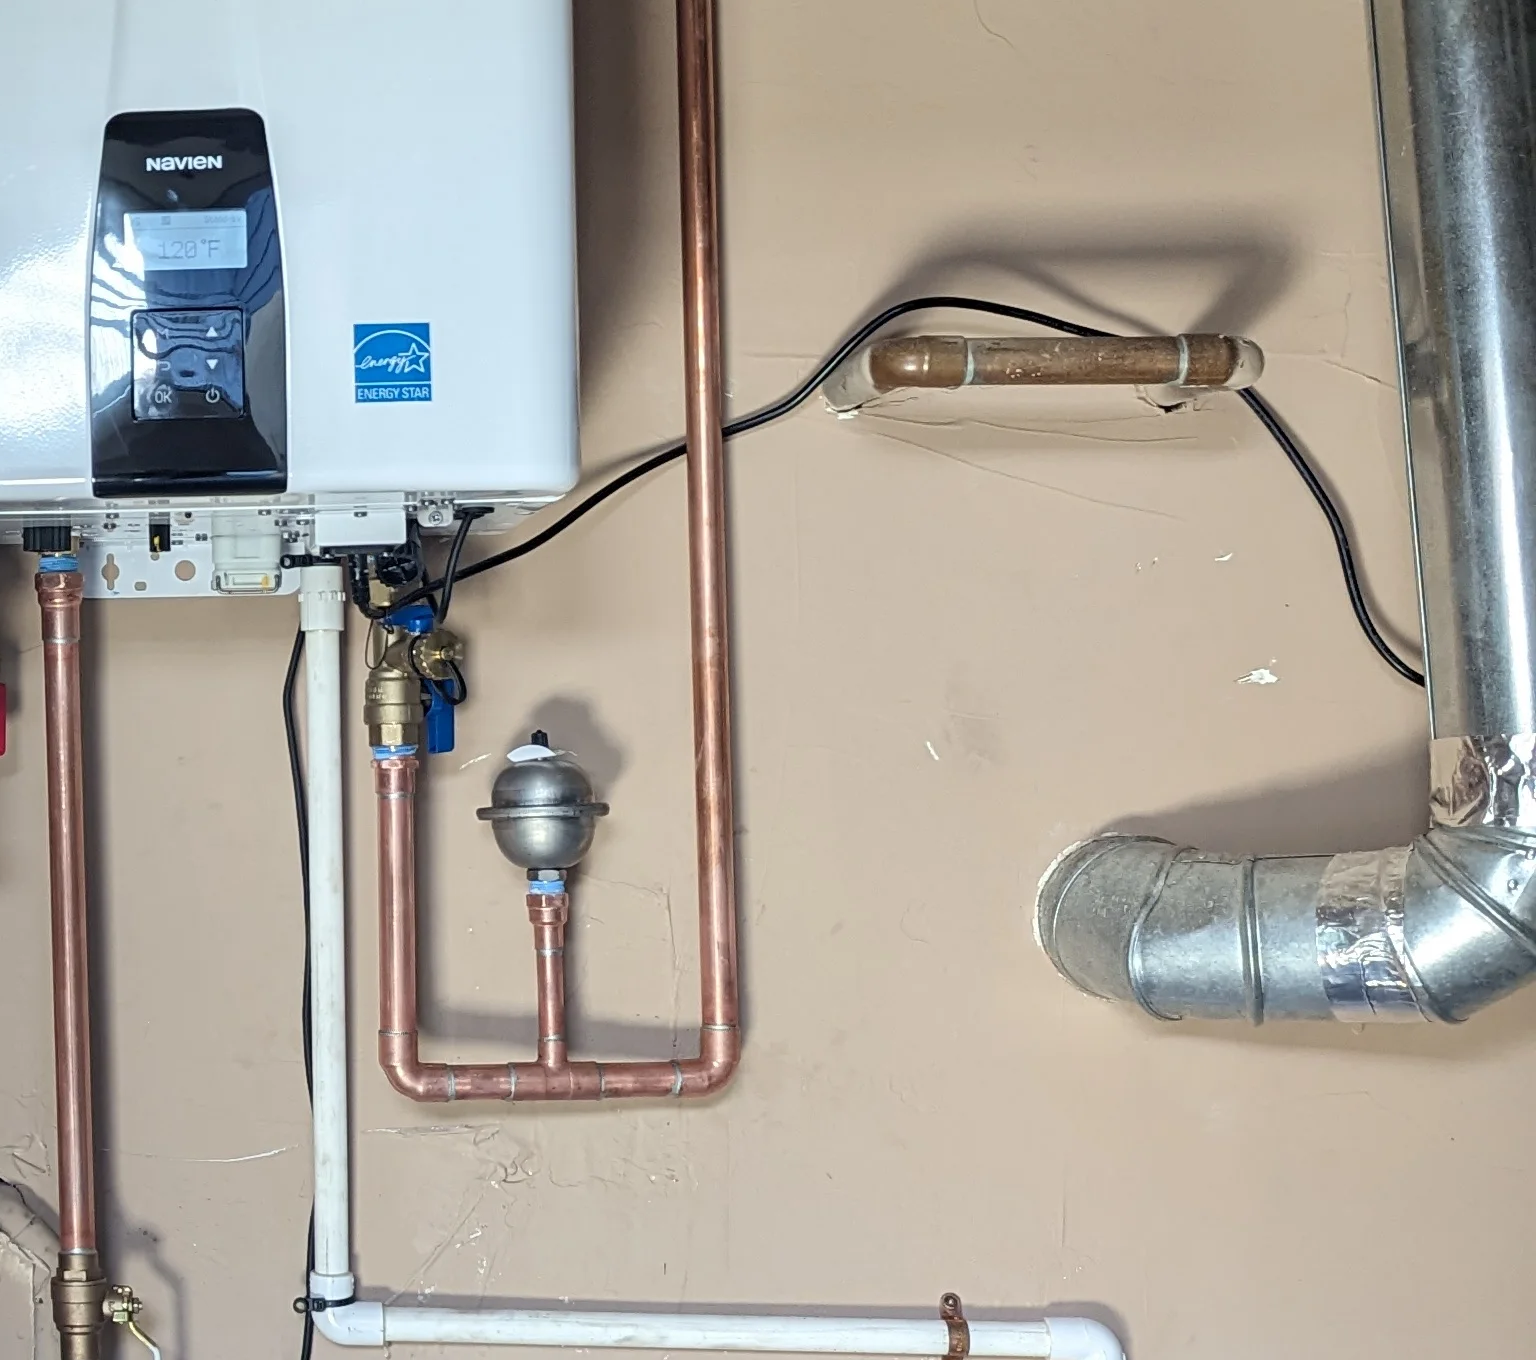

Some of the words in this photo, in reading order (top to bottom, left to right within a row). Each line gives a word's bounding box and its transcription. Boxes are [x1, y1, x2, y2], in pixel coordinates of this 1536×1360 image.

[154, 389, 173, 404] OK
[357, 387, 400, 400] ENERGY
[401, 386, 430, 398] STAR
